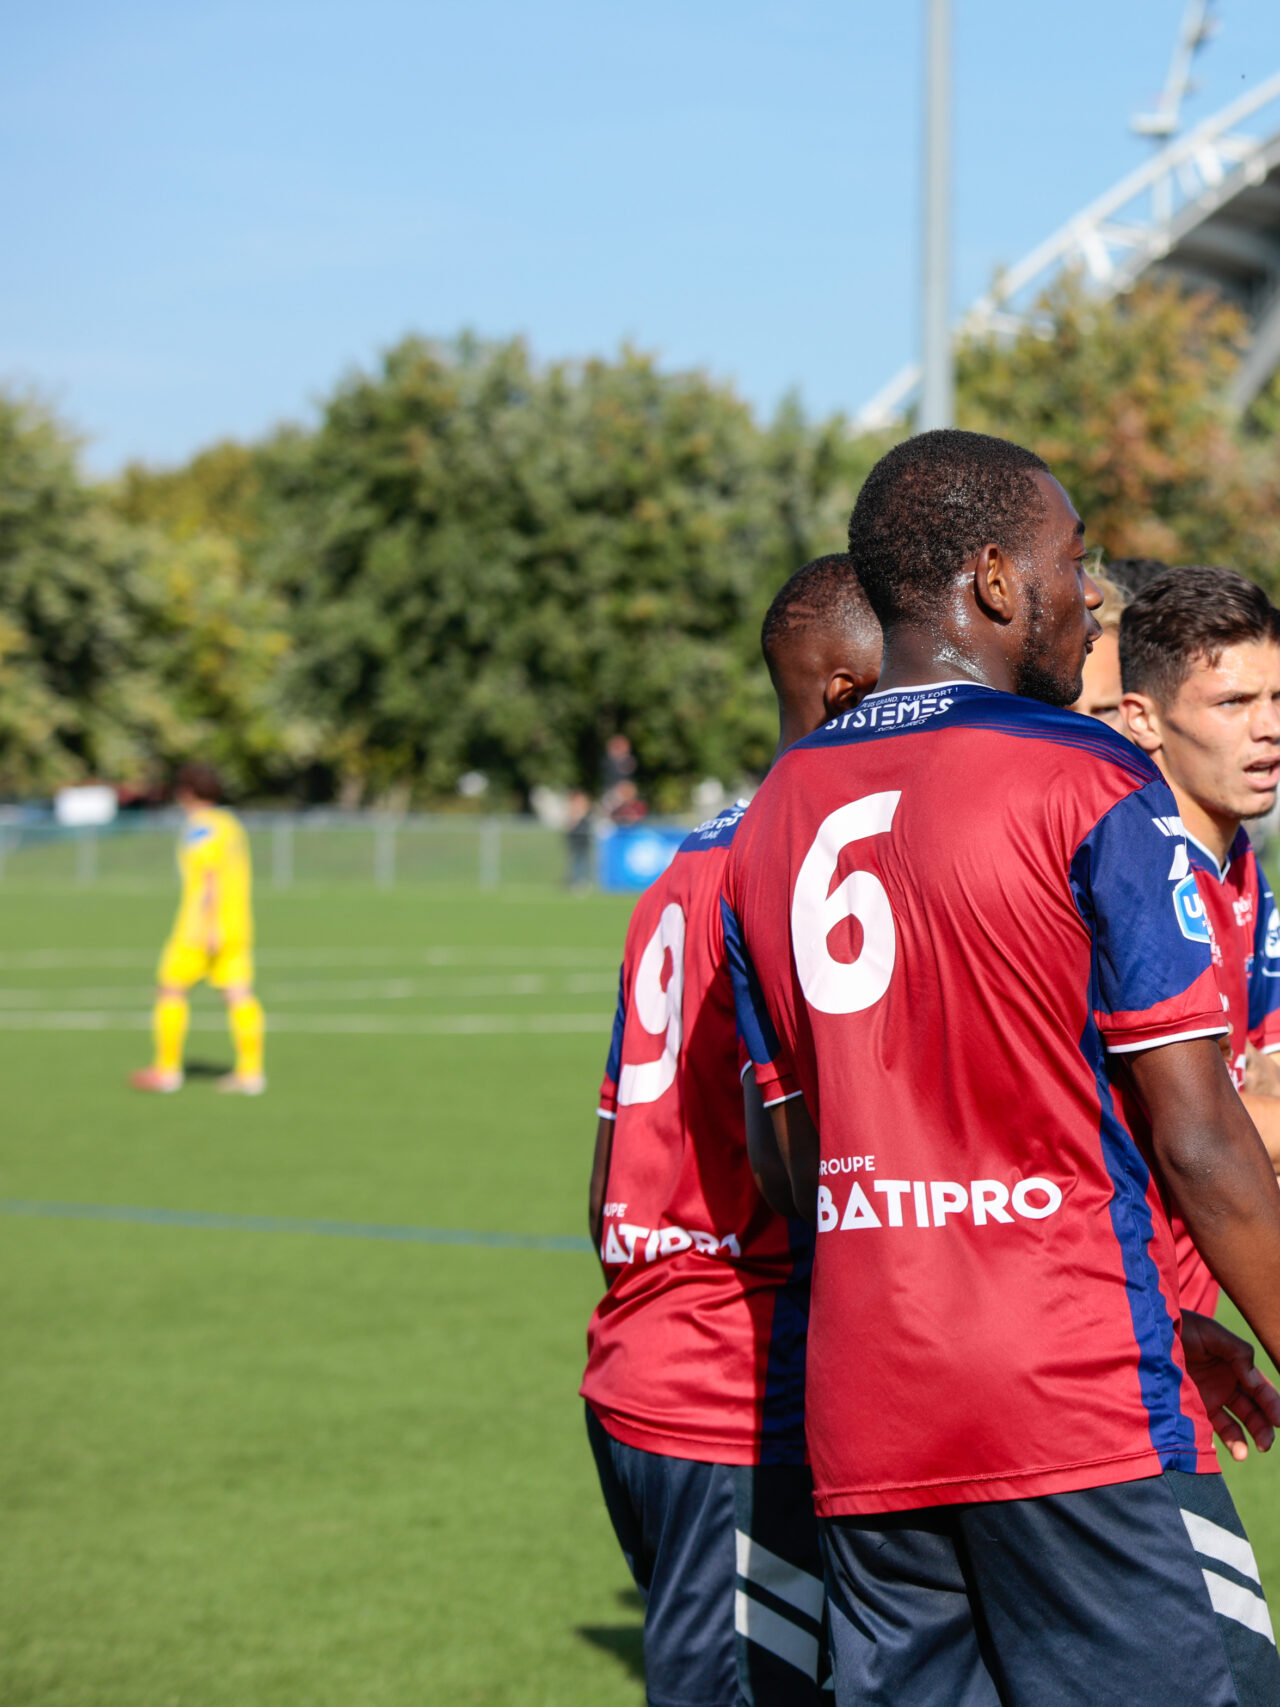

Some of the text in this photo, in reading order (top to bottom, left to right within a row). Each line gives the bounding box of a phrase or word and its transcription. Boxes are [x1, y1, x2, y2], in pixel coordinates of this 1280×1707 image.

[901, 694, 925, 702] PLUS
[928, 688, 952, 699] FORT
[790, 790, 902, 1015] 6
[617, 902, 685, 1107] 9
[818, 1155, 876, 1176] ROUPE
[817, 1177, 1063, 1233] BATIPRO
